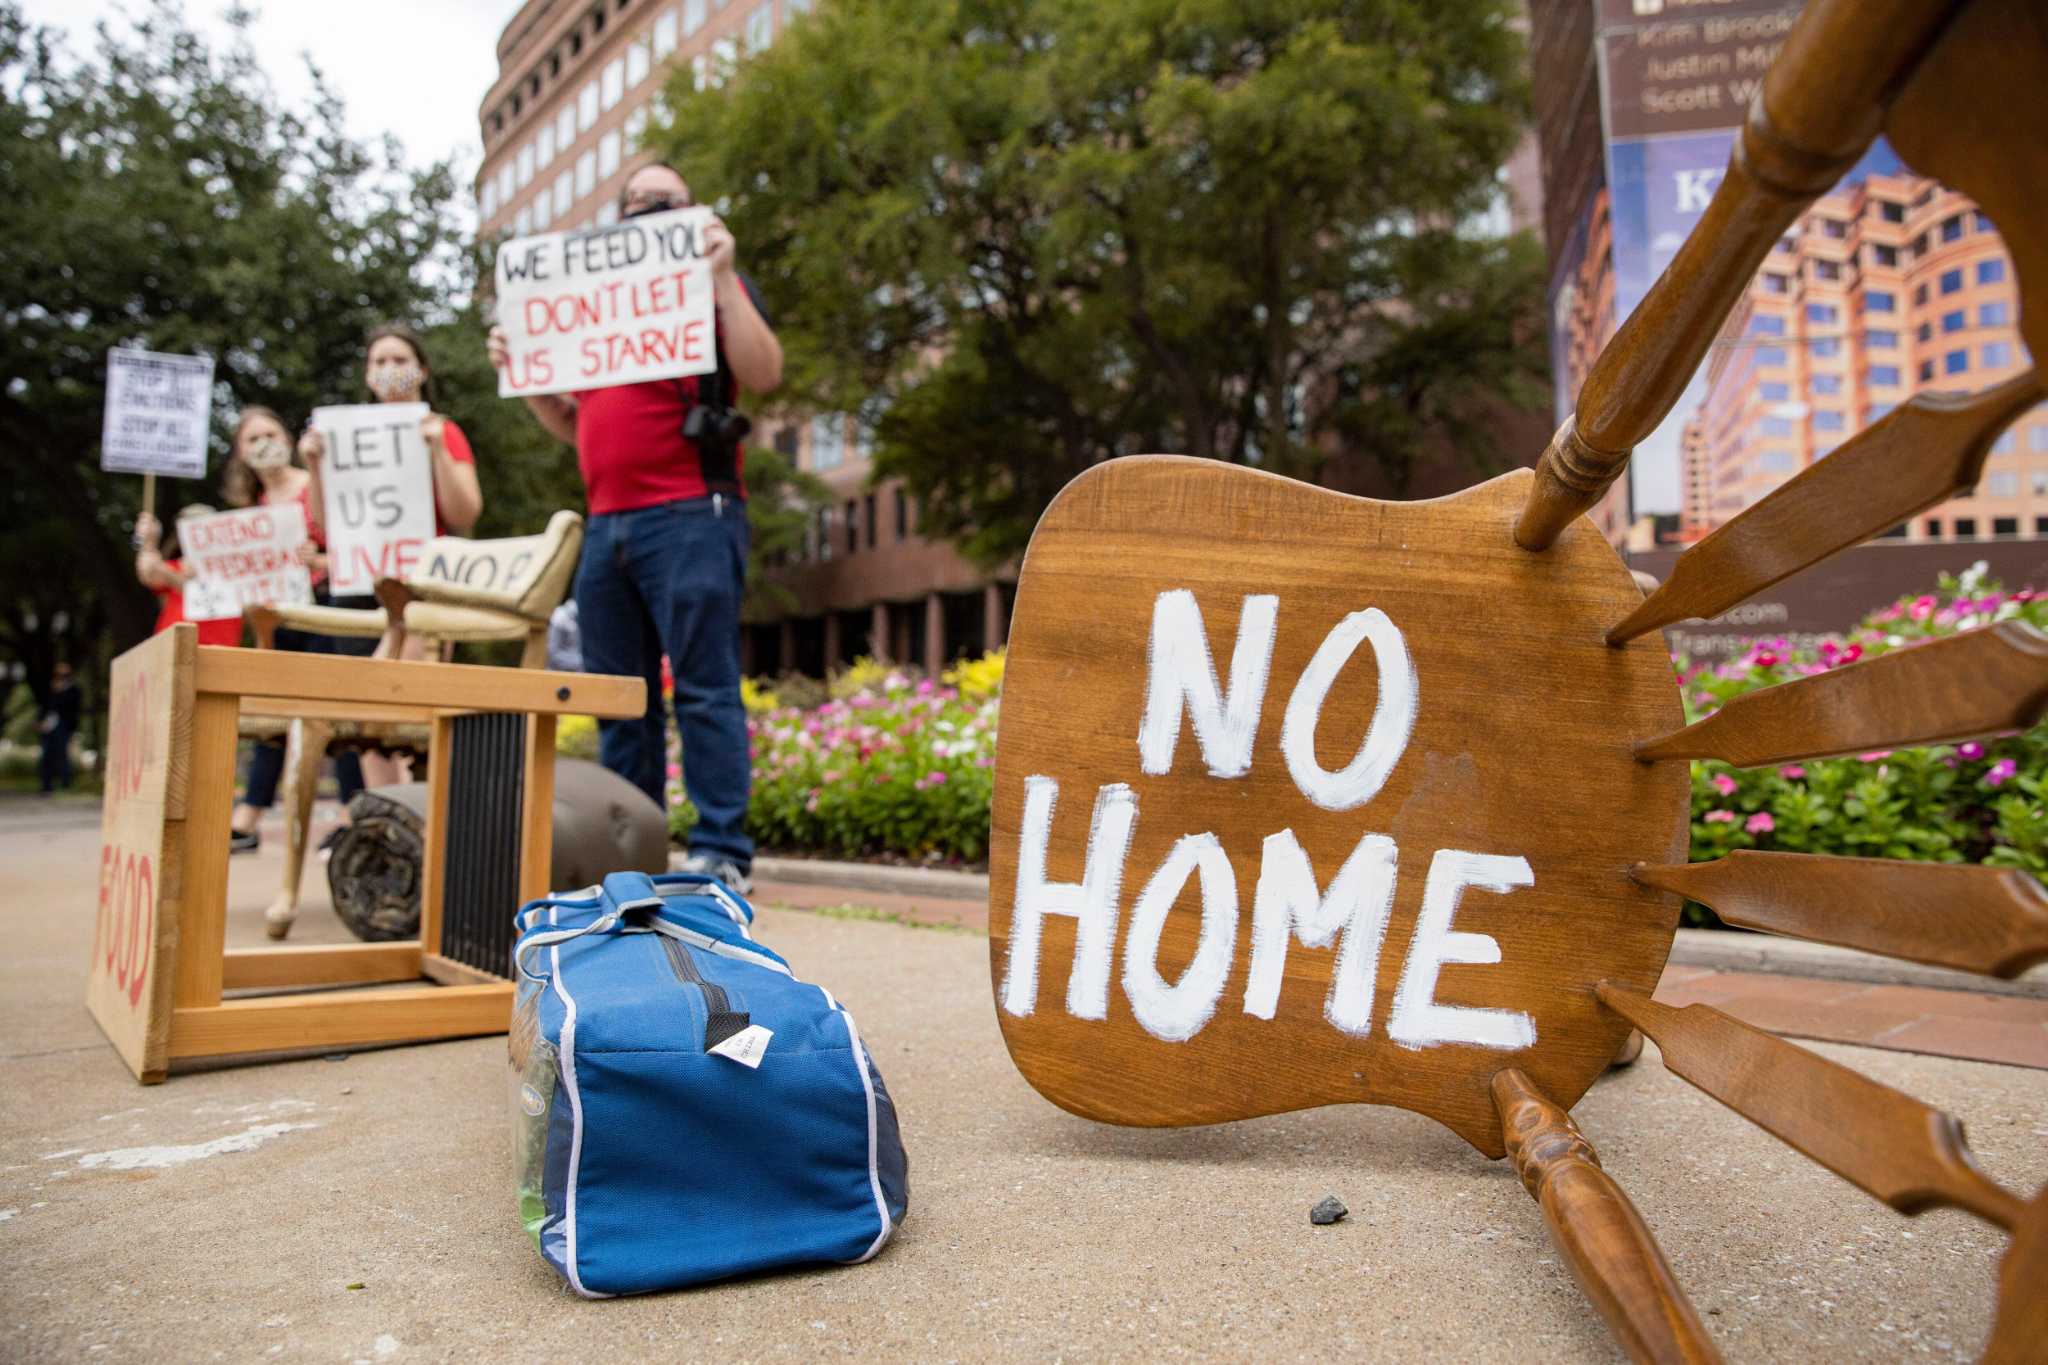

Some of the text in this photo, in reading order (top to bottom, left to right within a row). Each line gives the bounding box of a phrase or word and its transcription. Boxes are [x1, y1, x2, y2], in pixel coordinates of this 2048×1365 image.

[1646, 52, 1731, 81] Justin
[1640, 84, 1722, 114] Scott
[503, 223, 705, 283] WE FEED YOU
[630, 270, 692, 318] LET
[505, 320, 705, 390] US STARVE
[327, 423, 416, 471] LET
[337, 484, 404, 529] US
[189, 512, 274, 551] EXTEND
[330, 537, 424, 588] LIVE
[428, 552, 498, 588] NO
[1137, 588, 1420, 812] NO
[93, 843, 153, 1008] FOOD
[1000, 773, 1537, 1050] HOME
